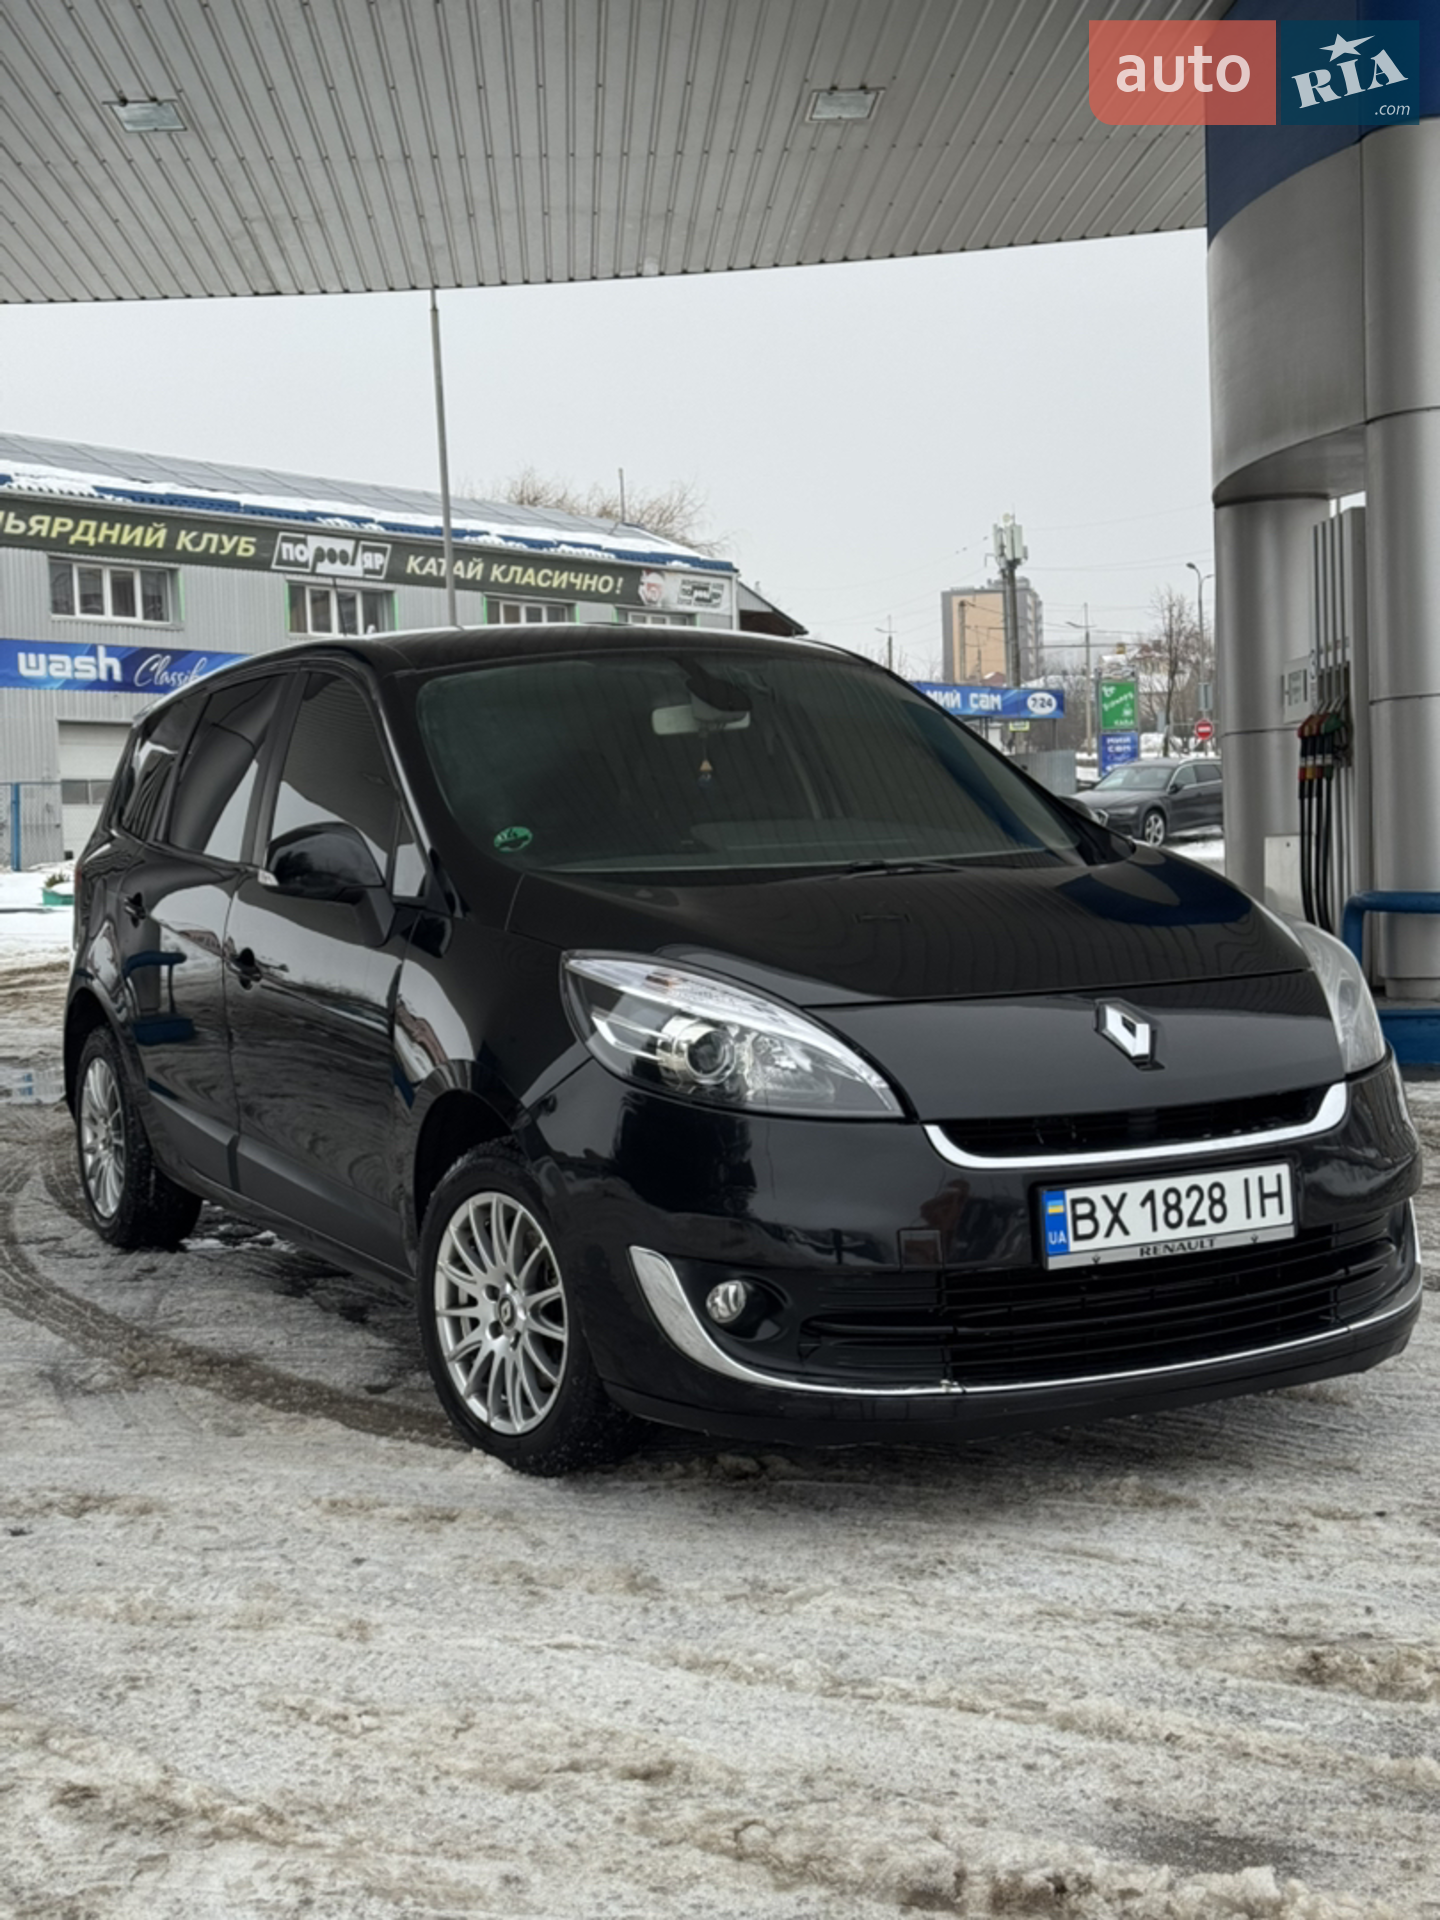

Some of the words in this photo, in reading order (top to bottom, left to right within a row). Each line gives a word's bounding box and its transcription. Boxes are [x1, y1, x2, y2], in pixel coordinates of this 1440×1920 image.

[175, 529, 257, 558] КЛУБ
[406, 554, 484, 581] КАТАЙ
[490, 564, 624, 595] КЛАСИЧНО!
[17, 645, 123, 682] wash
[1069, 1192, 1131, 1242] BX
[1139, 1181, 1228, 1233] 1828
[1244, 1173, 1284, 1220] IH
[1049, 1231, 1067, 1245] UA
[1139, 1237, 1217, 1258] RENAULT
